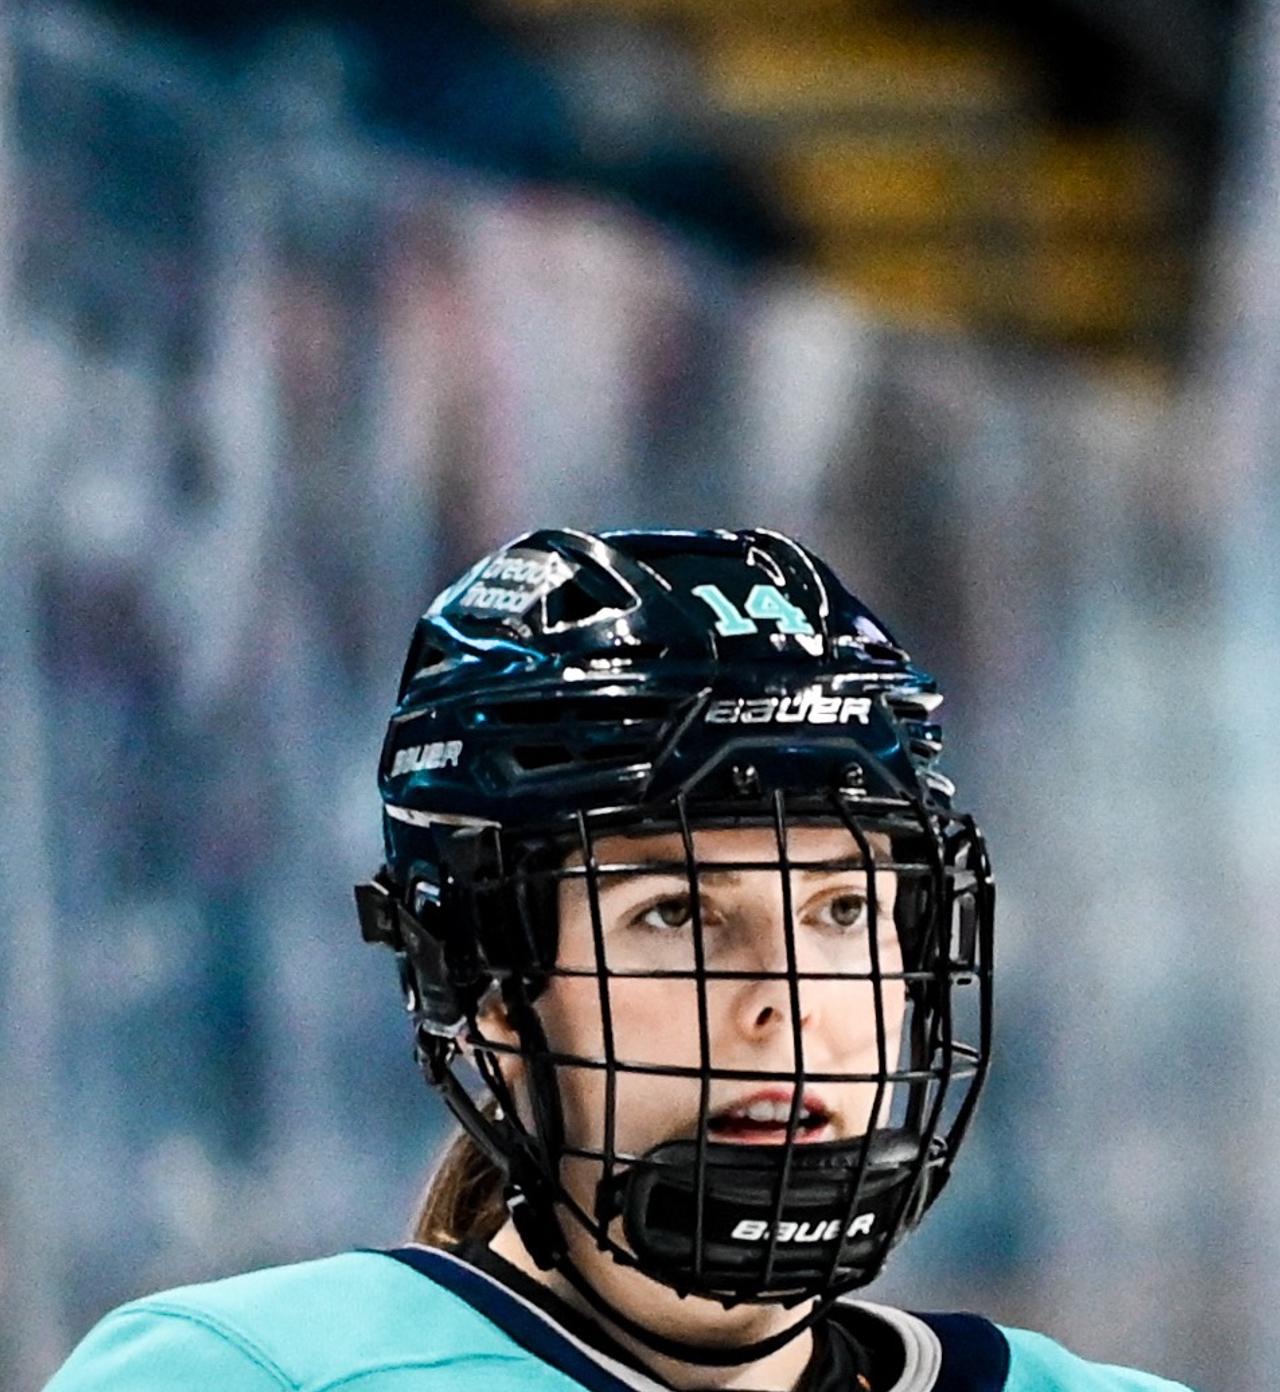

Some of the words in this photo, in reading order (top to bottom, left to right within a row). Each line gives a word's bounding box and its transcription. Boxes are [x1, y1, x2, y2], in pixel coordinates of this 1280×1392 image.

[690, 584, 815, 636] 14
[704, 697, 872, 724] BAUER
[731, 1212, 875, 1243] BAUER
